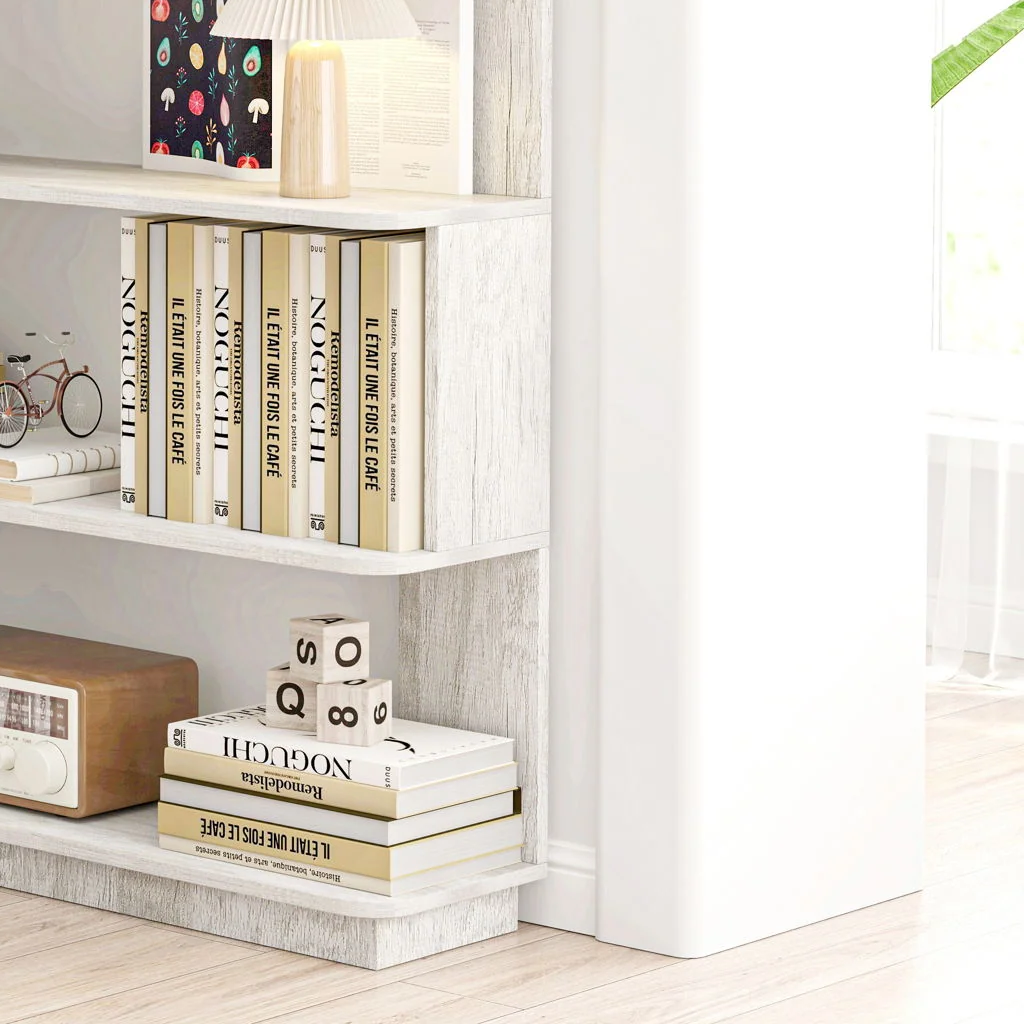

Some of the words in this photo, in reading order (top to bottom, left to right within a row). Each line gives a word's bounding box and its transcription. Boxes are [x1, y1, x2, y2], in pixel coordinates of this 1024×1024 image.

[172, 297, 185, 309] IL
[267, 307, 280, 320] IL
[171, 312, 187, 350] ÉTAIT
[365, 317, 379, 330] IL
[266, 322, 283, 361] ÉTAIT
[365, 333, 381, 372] ÉTAIT
[122, 275, 136, 438] NOGUCHI
[171, 351, 185, 379] UNE
[214, 285, 229, 450] NOGUCHI
[266, 363, 280, 390] UNE
[310, 294, 326, 463] NOGUCHI
[365, 374, 379, 401] UNE
[171, 381, 185, 410] FOIS
[266, 392, 280, 422] FOIS
[171, 413, 185, 429] LE
[266, 425, 280, 441] LE
[365, 404, 379, 434] FOIS
[171, 431, 187, 465] CAFÉ
[365, 437, 379, 454] LE
[266, 444, 283, 478] CAFÉ
[365, 457, 381, 492] CAFÉ
[296, 638, 317, 665] S
[276, 682, 305, 719] Q
[223, 736, 352, 781] NOGUCHI
[241, 771, 323, 800] Remodelista
[200, 818, 226, 838] CAFÉ
[228, 823, 240, 841] LE
[243, 826, 264, 846] FOIS
[267, 831, 287, 852] UNE
[290, 836, 318, 860] ÉTAIT
[321, 842, 330, 860] IL
